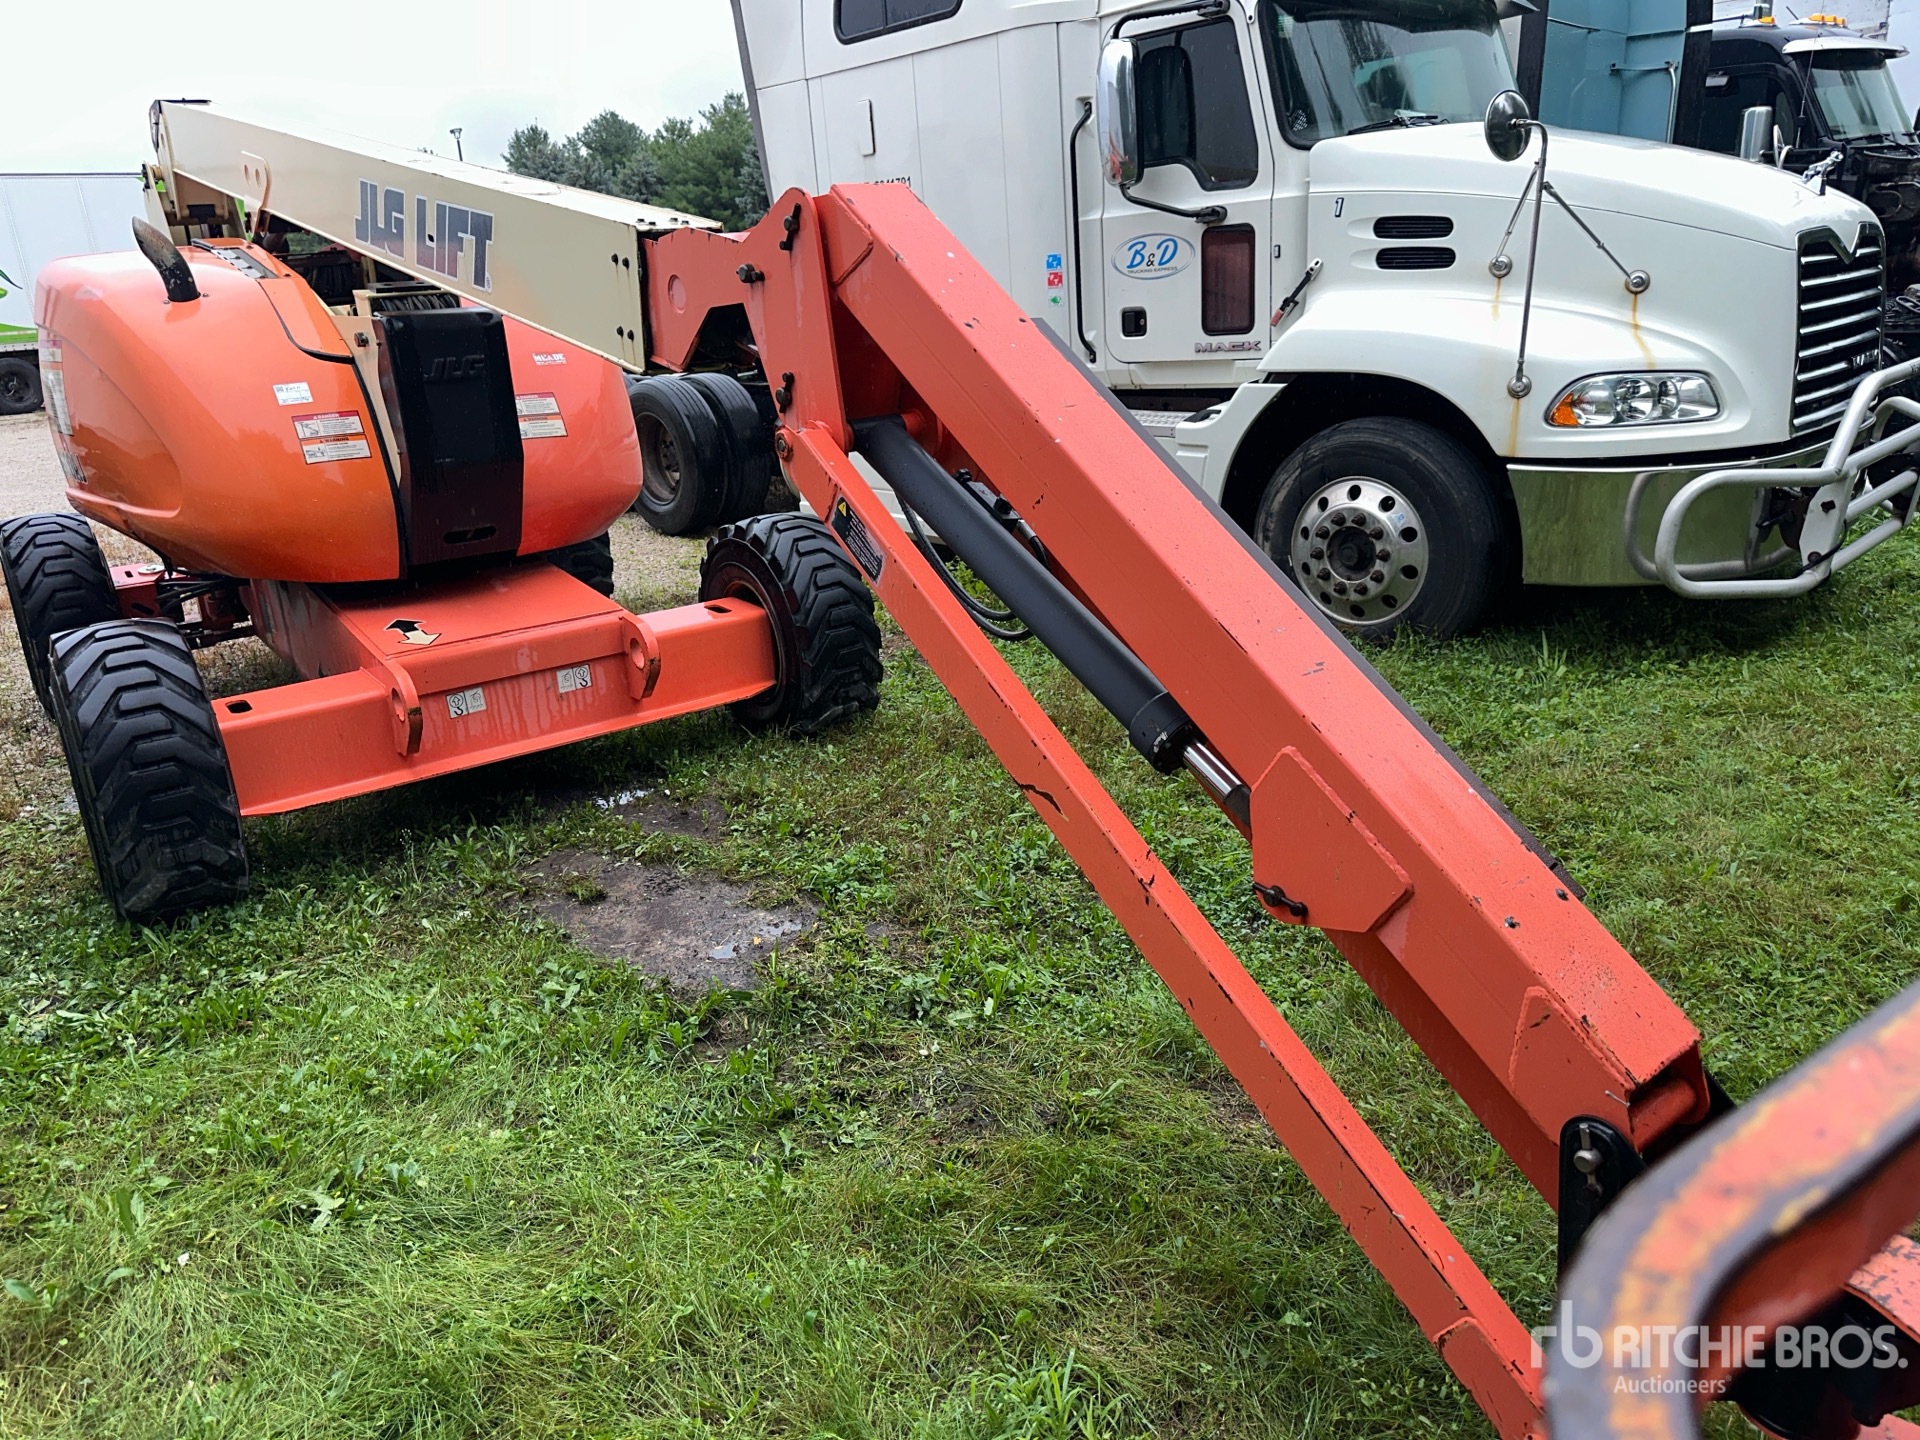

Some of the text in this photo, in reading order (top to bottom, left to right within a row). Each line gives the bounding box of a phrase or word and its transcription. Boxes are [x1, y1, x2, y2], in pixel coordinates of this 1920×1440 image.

[1335, 197, 1344, 217] 1
[354, 178, 494, 292] JLG LIFT
[1194, 341, 1262, 353] MACK
[423, 354, 485, 380] JLG
